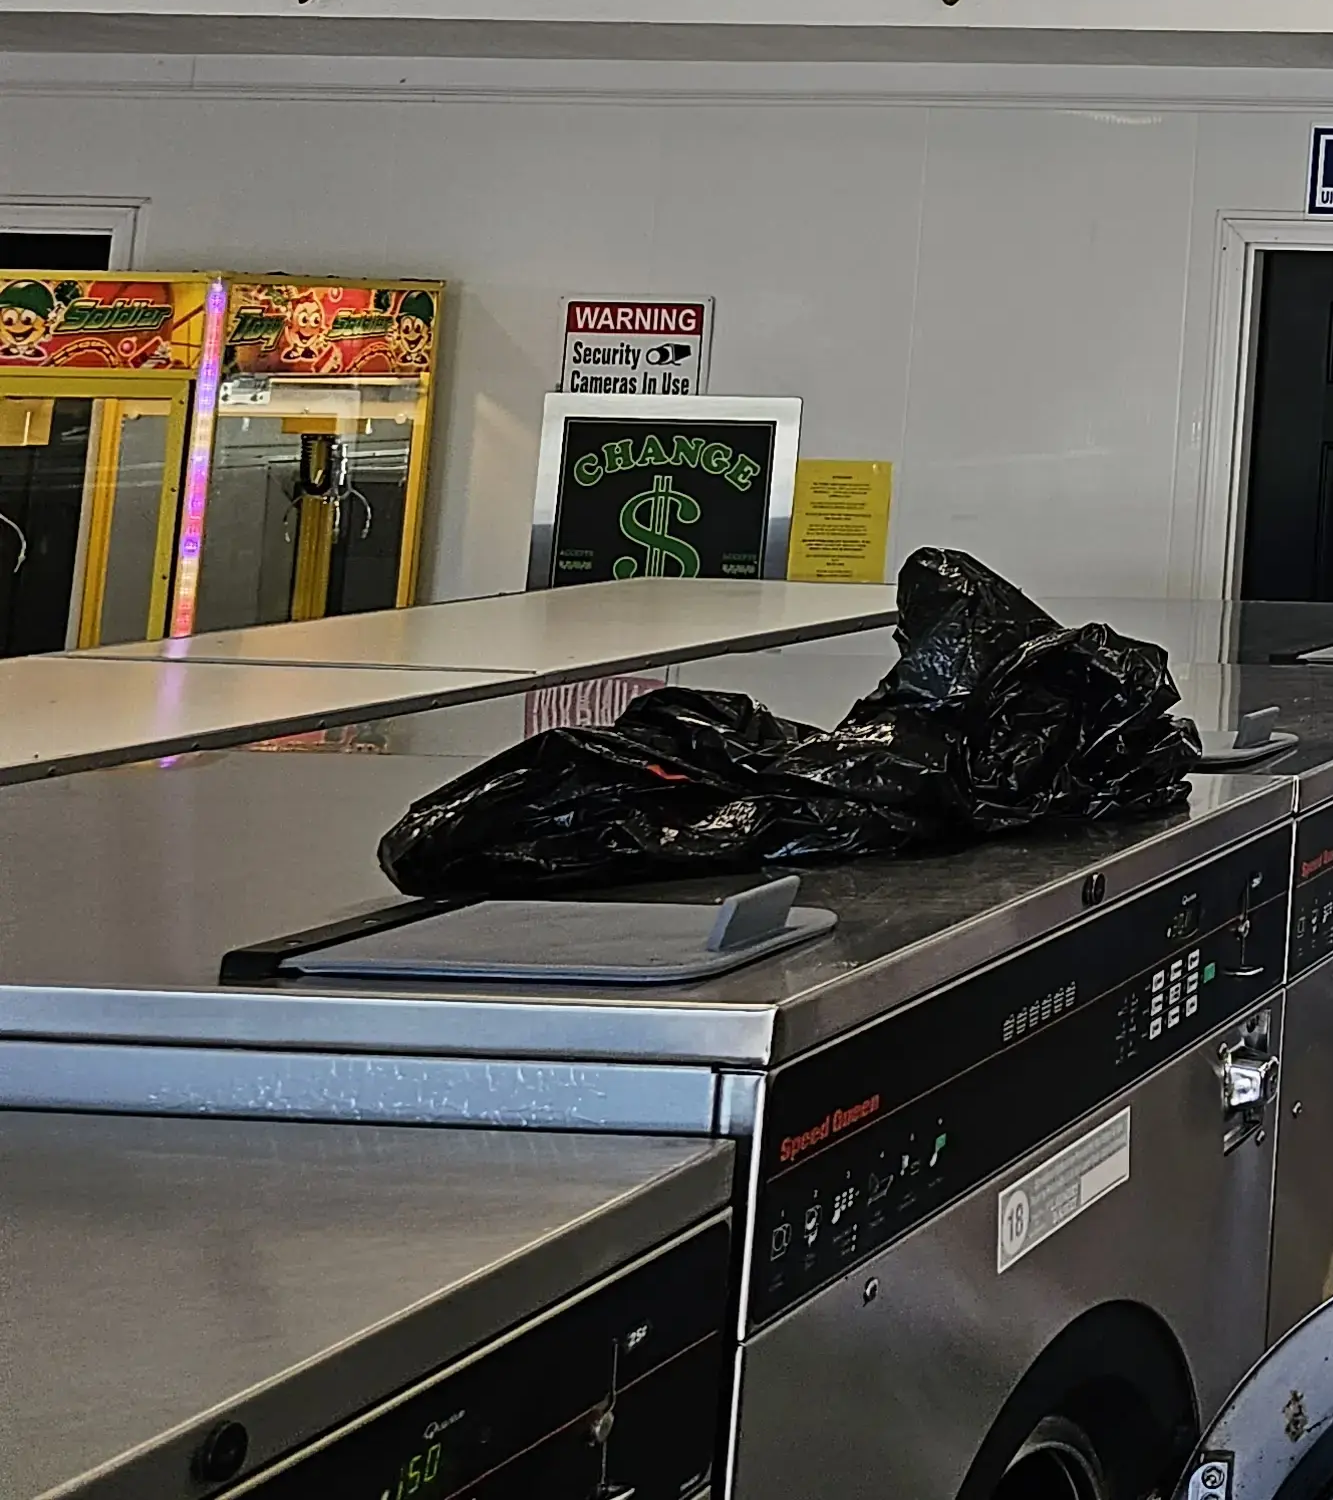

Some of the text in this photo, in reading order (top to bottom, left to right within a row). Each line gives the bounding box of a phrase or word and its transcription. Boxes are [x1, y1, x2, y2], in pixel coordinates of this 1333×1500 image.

[56, 299, 171, 330] Soldier
[229, 307, 286, 351] Toy
[575, 306, 697, 331] WARNING
[572, 341, 642, 370] Security
[570, 370, 690, 396] Cameras In Use
[574, 435, 760, 491] CHANGE
[780, 1093, 880, 1162] Speed Queen
[1008, 1202, 1024, 1242] 18
